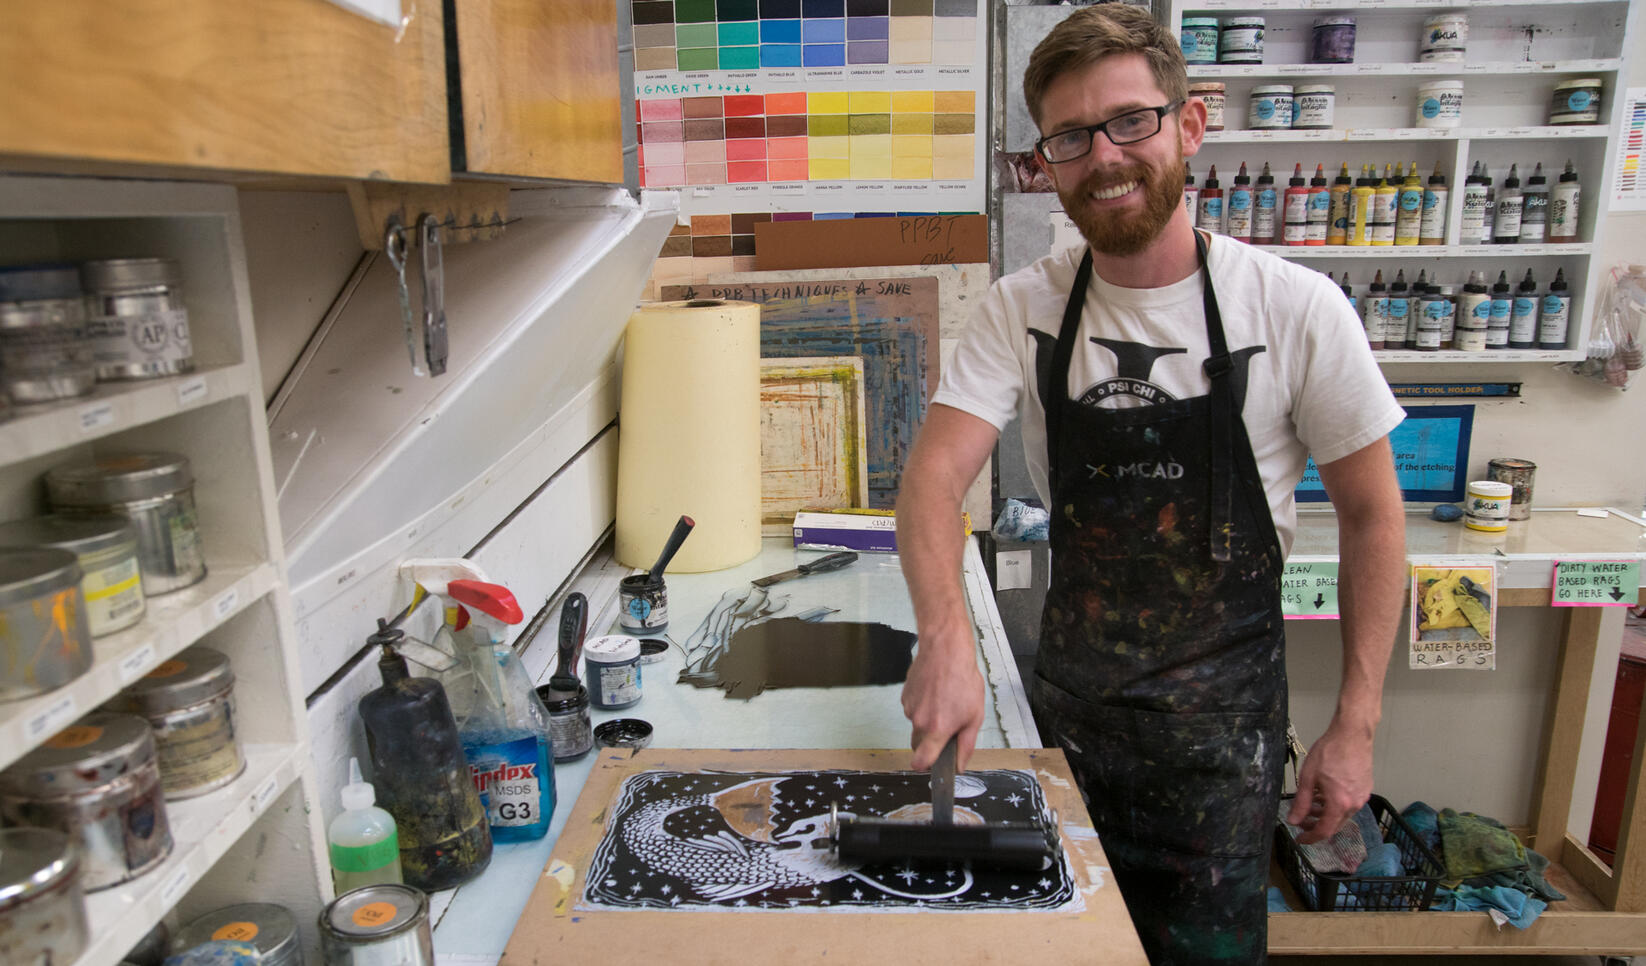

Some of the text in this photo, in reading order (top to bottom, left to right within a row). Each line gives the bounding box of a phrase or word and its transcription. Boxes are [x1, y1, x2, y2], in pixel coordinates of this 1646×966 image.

[636, 84, 701, 94] IGMENT
[876, 281, 912, 295] SAVE
[1108, 382, 1156, 399] PSI CHI
[1448, 386, 1484, 394] HOLDER
[1118, 462, 1184, 479] MCAD
[1405, 463, 1419, 471] the
[1421, 463, 1455, 472] etching
[1284, 565, 1312, 575] LEAN
[1561, 563, 1628, 573] DIRTY WATER
[1283, 578, 1337, 588] ATER BASE
[1559, 576, 1620, 586] BASED RAGS
[1559, 589, 1603, 598] GO HERE
[1281, 594, 1302, 604] AGS
[470, 763, 535, 792] index
[495, 784, 532, 796] MSDS
[499, 802, 531, 820] G3
